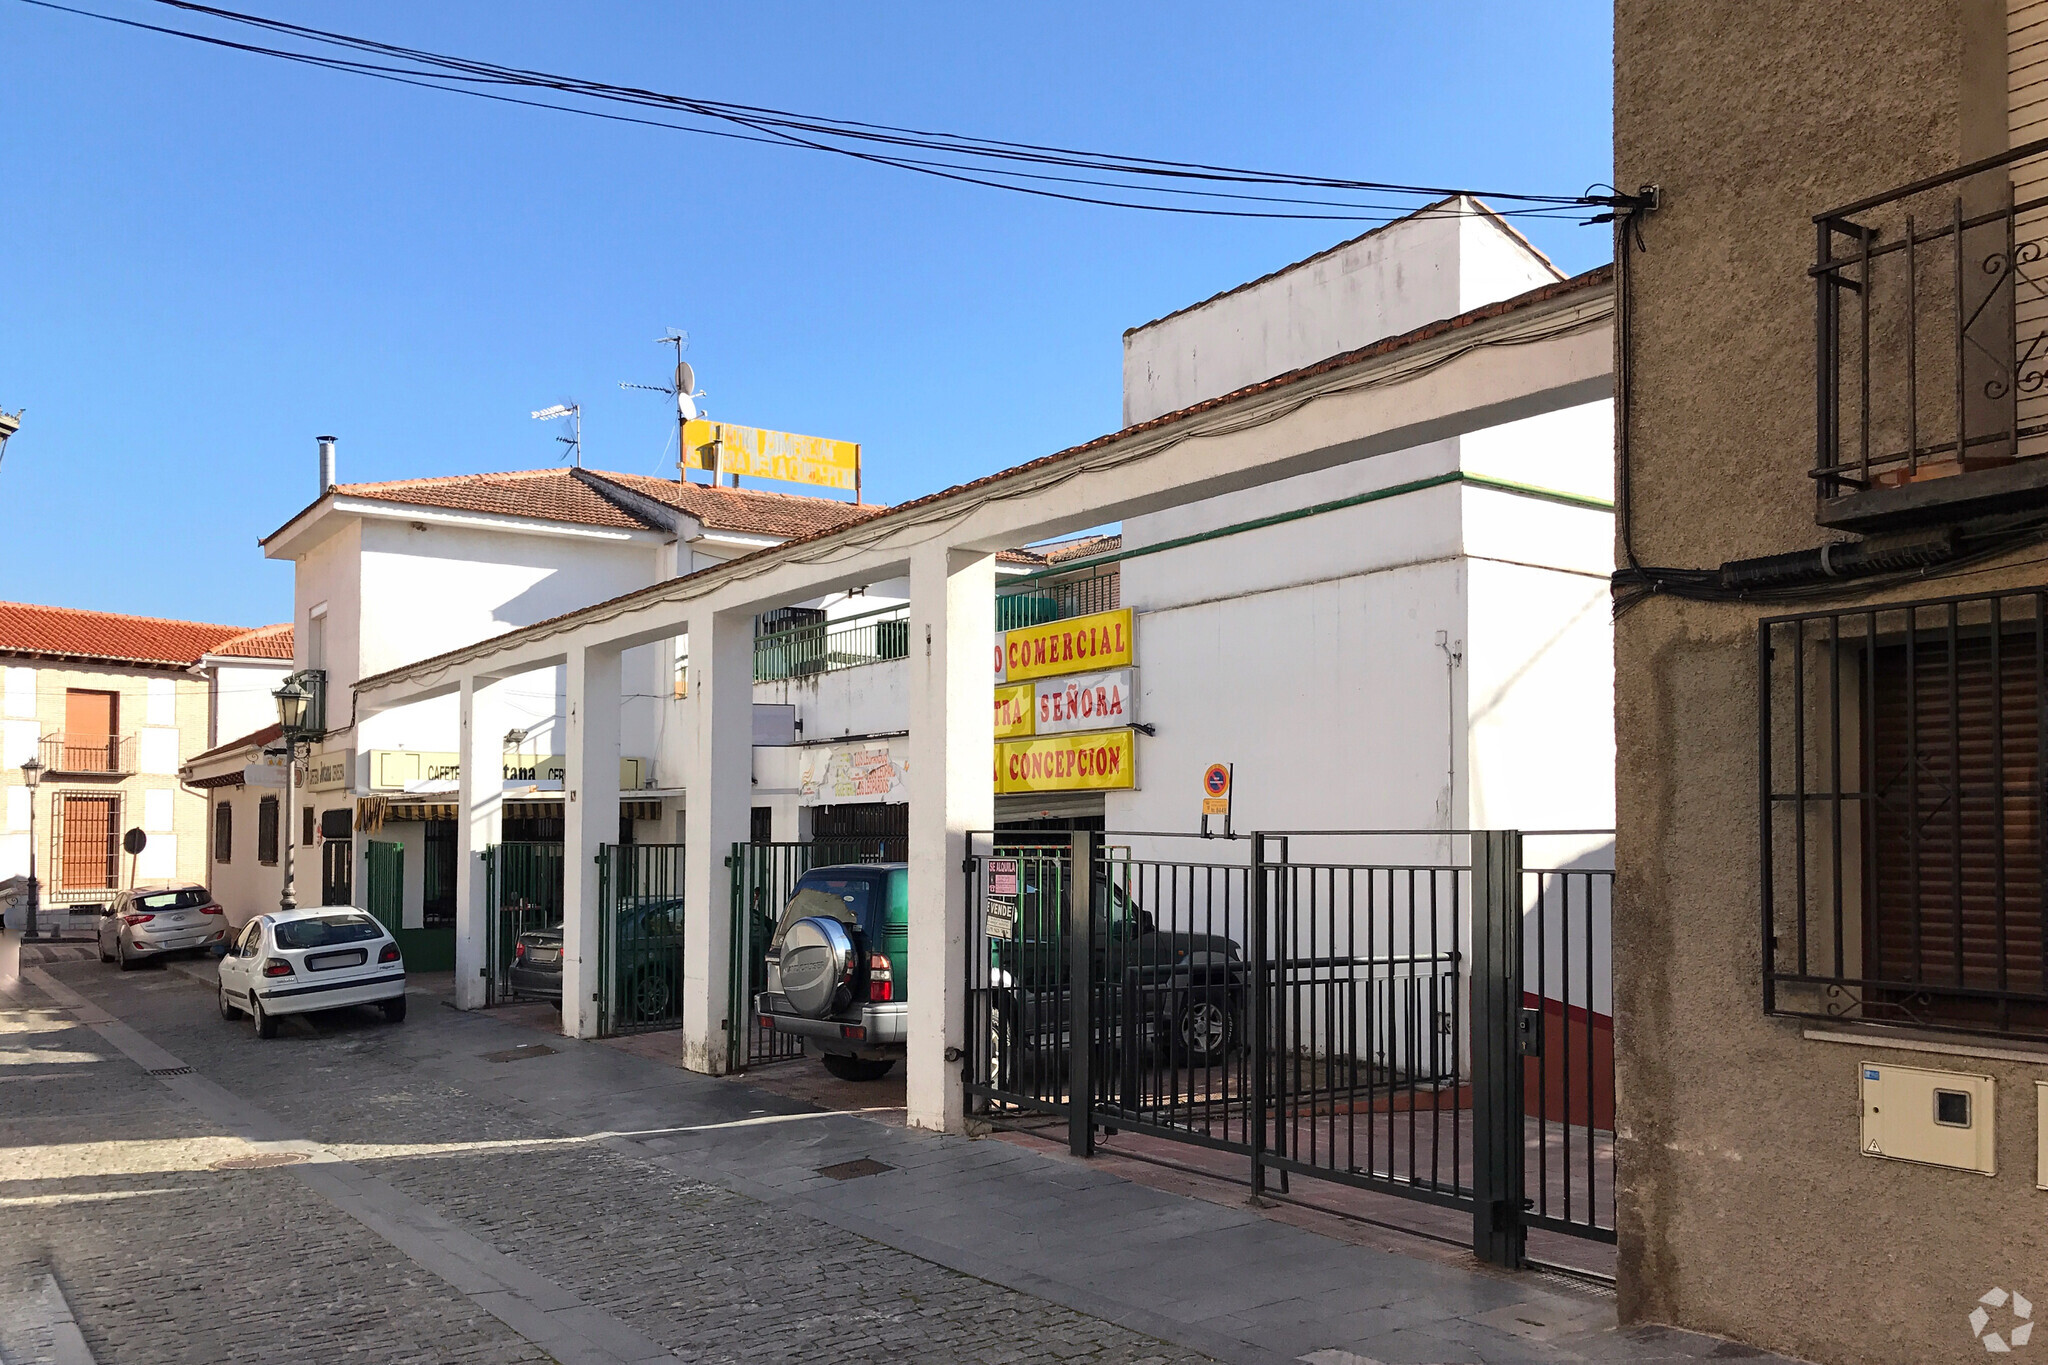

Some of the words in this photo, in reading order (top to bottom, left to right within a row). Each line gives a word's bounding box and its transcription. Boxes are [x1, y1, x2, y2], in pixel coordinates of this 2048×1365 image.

[1009, 623, 1125, 669] COMERCIAL
[1040, 683, 1124, 723] SEÑORA
[548, 767, 565, 784] CER
[1009, 746, 1121, 781] CONCEPCION
[989, 862, 996, 872] SE
[996, 862, 1015, 873] ALQUILA
[990, 903, 1012, 917] VENDE
